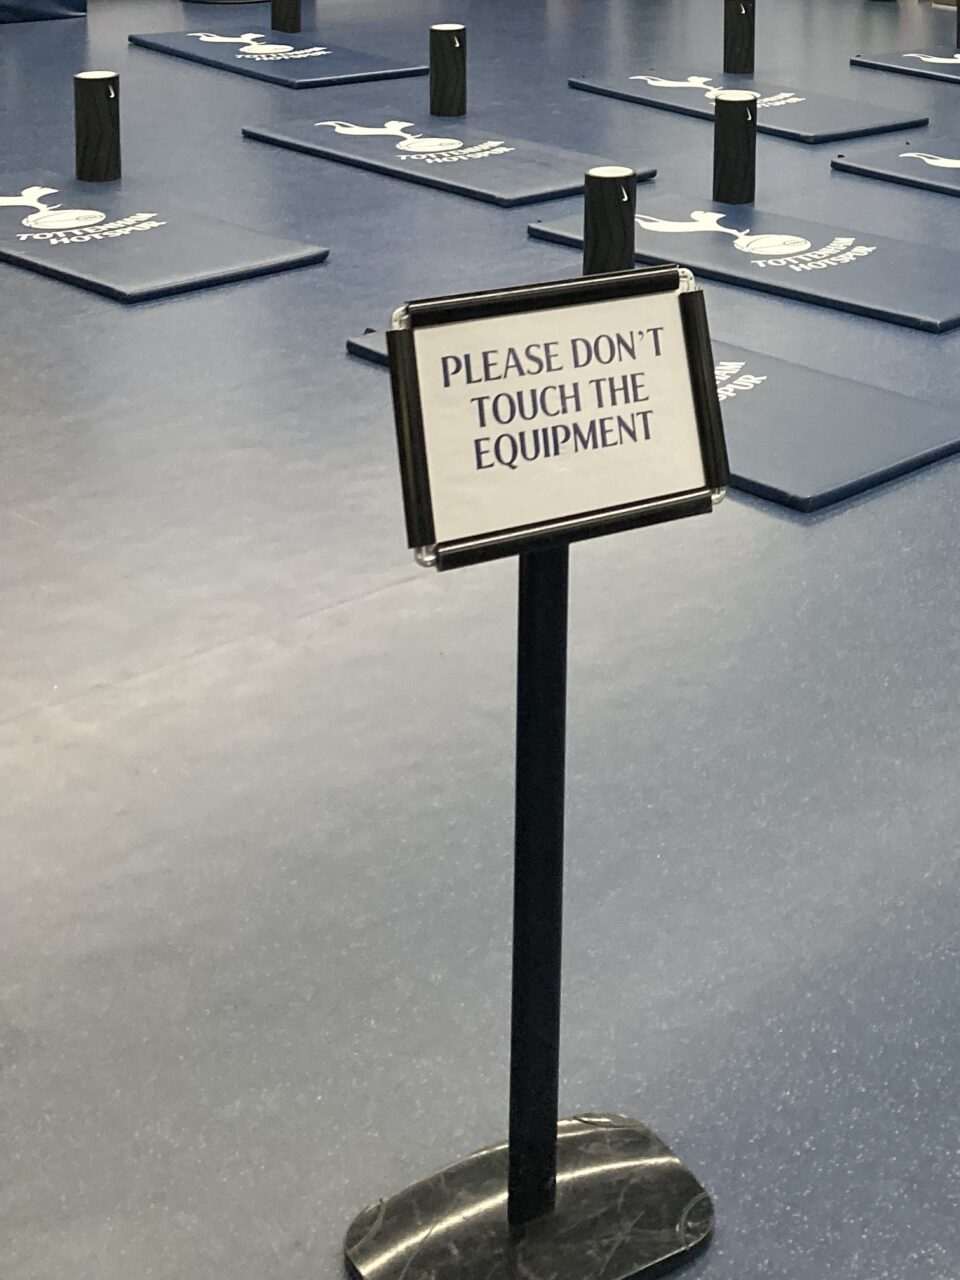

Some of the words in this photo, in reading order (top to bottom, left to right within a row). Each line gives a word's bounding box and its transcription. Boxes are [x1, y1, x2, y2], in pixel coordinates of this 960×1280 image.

[441, 342, 563, 388] PLEASE
[571, 327, 664, 370] DON'T
[471, 382, 582, 428] TOUCH
[589, 372, 650, 409] THE
[474, 410, 653, 470] EQUIPMENT
